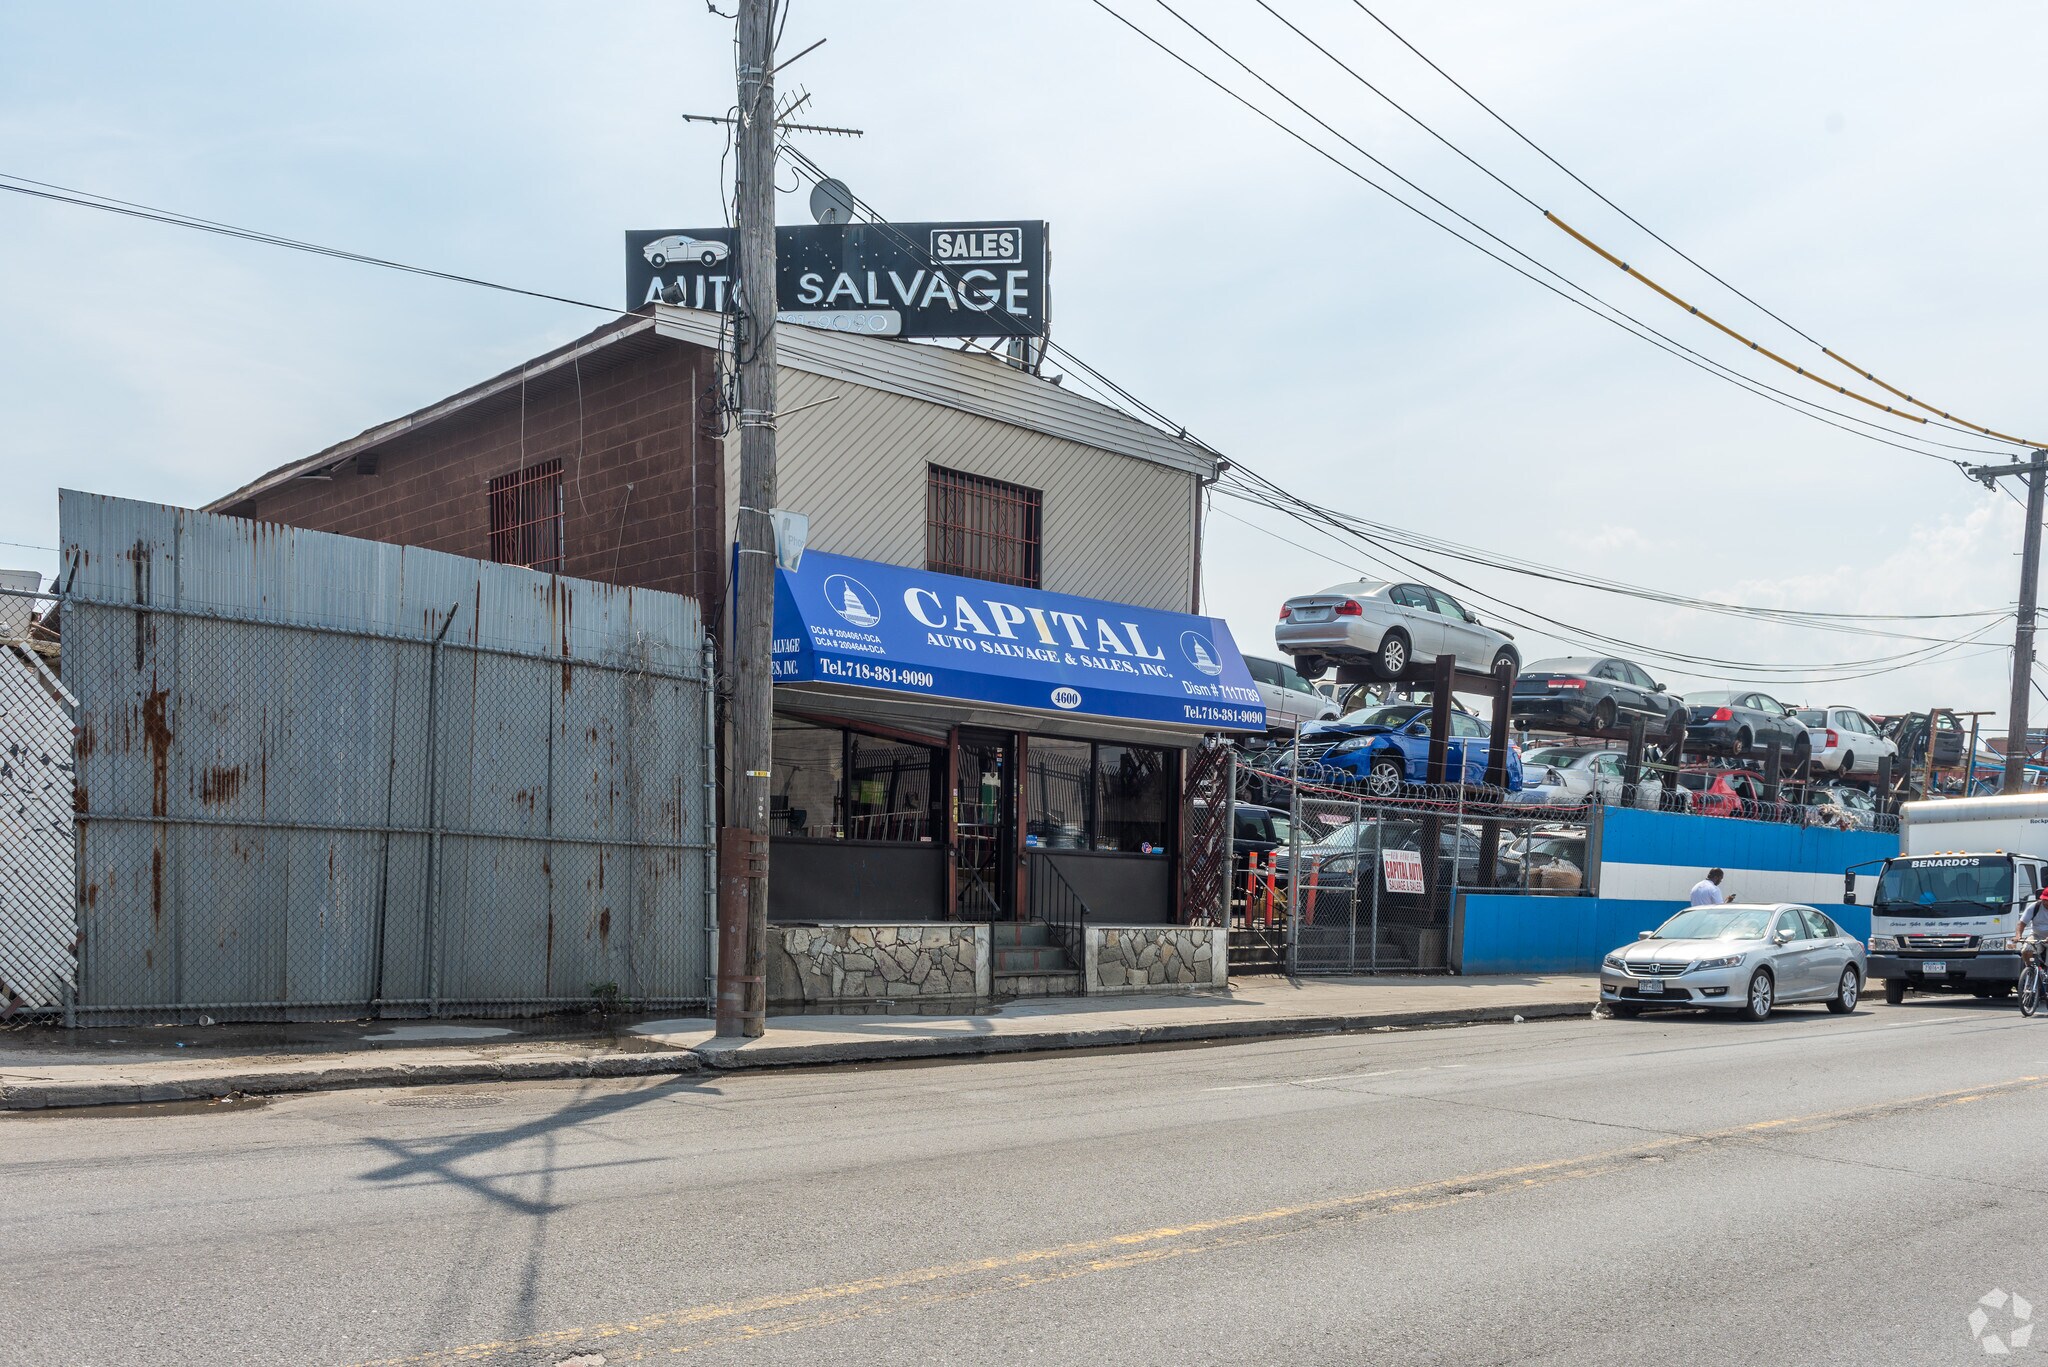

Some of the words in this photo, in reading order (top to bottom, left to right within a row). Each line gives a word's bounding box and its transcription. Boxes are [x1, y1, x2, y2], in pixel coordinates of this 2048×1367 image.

[937, 232, 1015, 258] SALES
[797, 269, 1029, 315] SALVAGE
[810, 625, 829, 636] DCA
[903, 587, 1166, 661] CAPITAL
[772, 638, 800, 654] ALVAGE
[815, 636, 833, 647] DCA
[927, 632, 977, 652] AUTO
[982, 640, 1061, 664] SALVAGE
[1064, 652, 1078, 666] &
[1081, 655, 1140, 676] SALES,
[1140, 663, 1174, 679] INC.
[783, 660, 799, 675] INC.
[820, 658, 933, 688] Tel.718-381-9090
[1054, 691, 1078, 705] 4600
[1182, 680, 1211, 697] Dism
[1219, 685, 1260, 703] 7117789
[1184, 704, 1263, 724] Tel.718-381-9090
[1385, 860, 1408, 879] CAPITAL
[1409, 863, 1422, 881] AUTO
[1911, 858, 1980, 868] BENARDO'S
